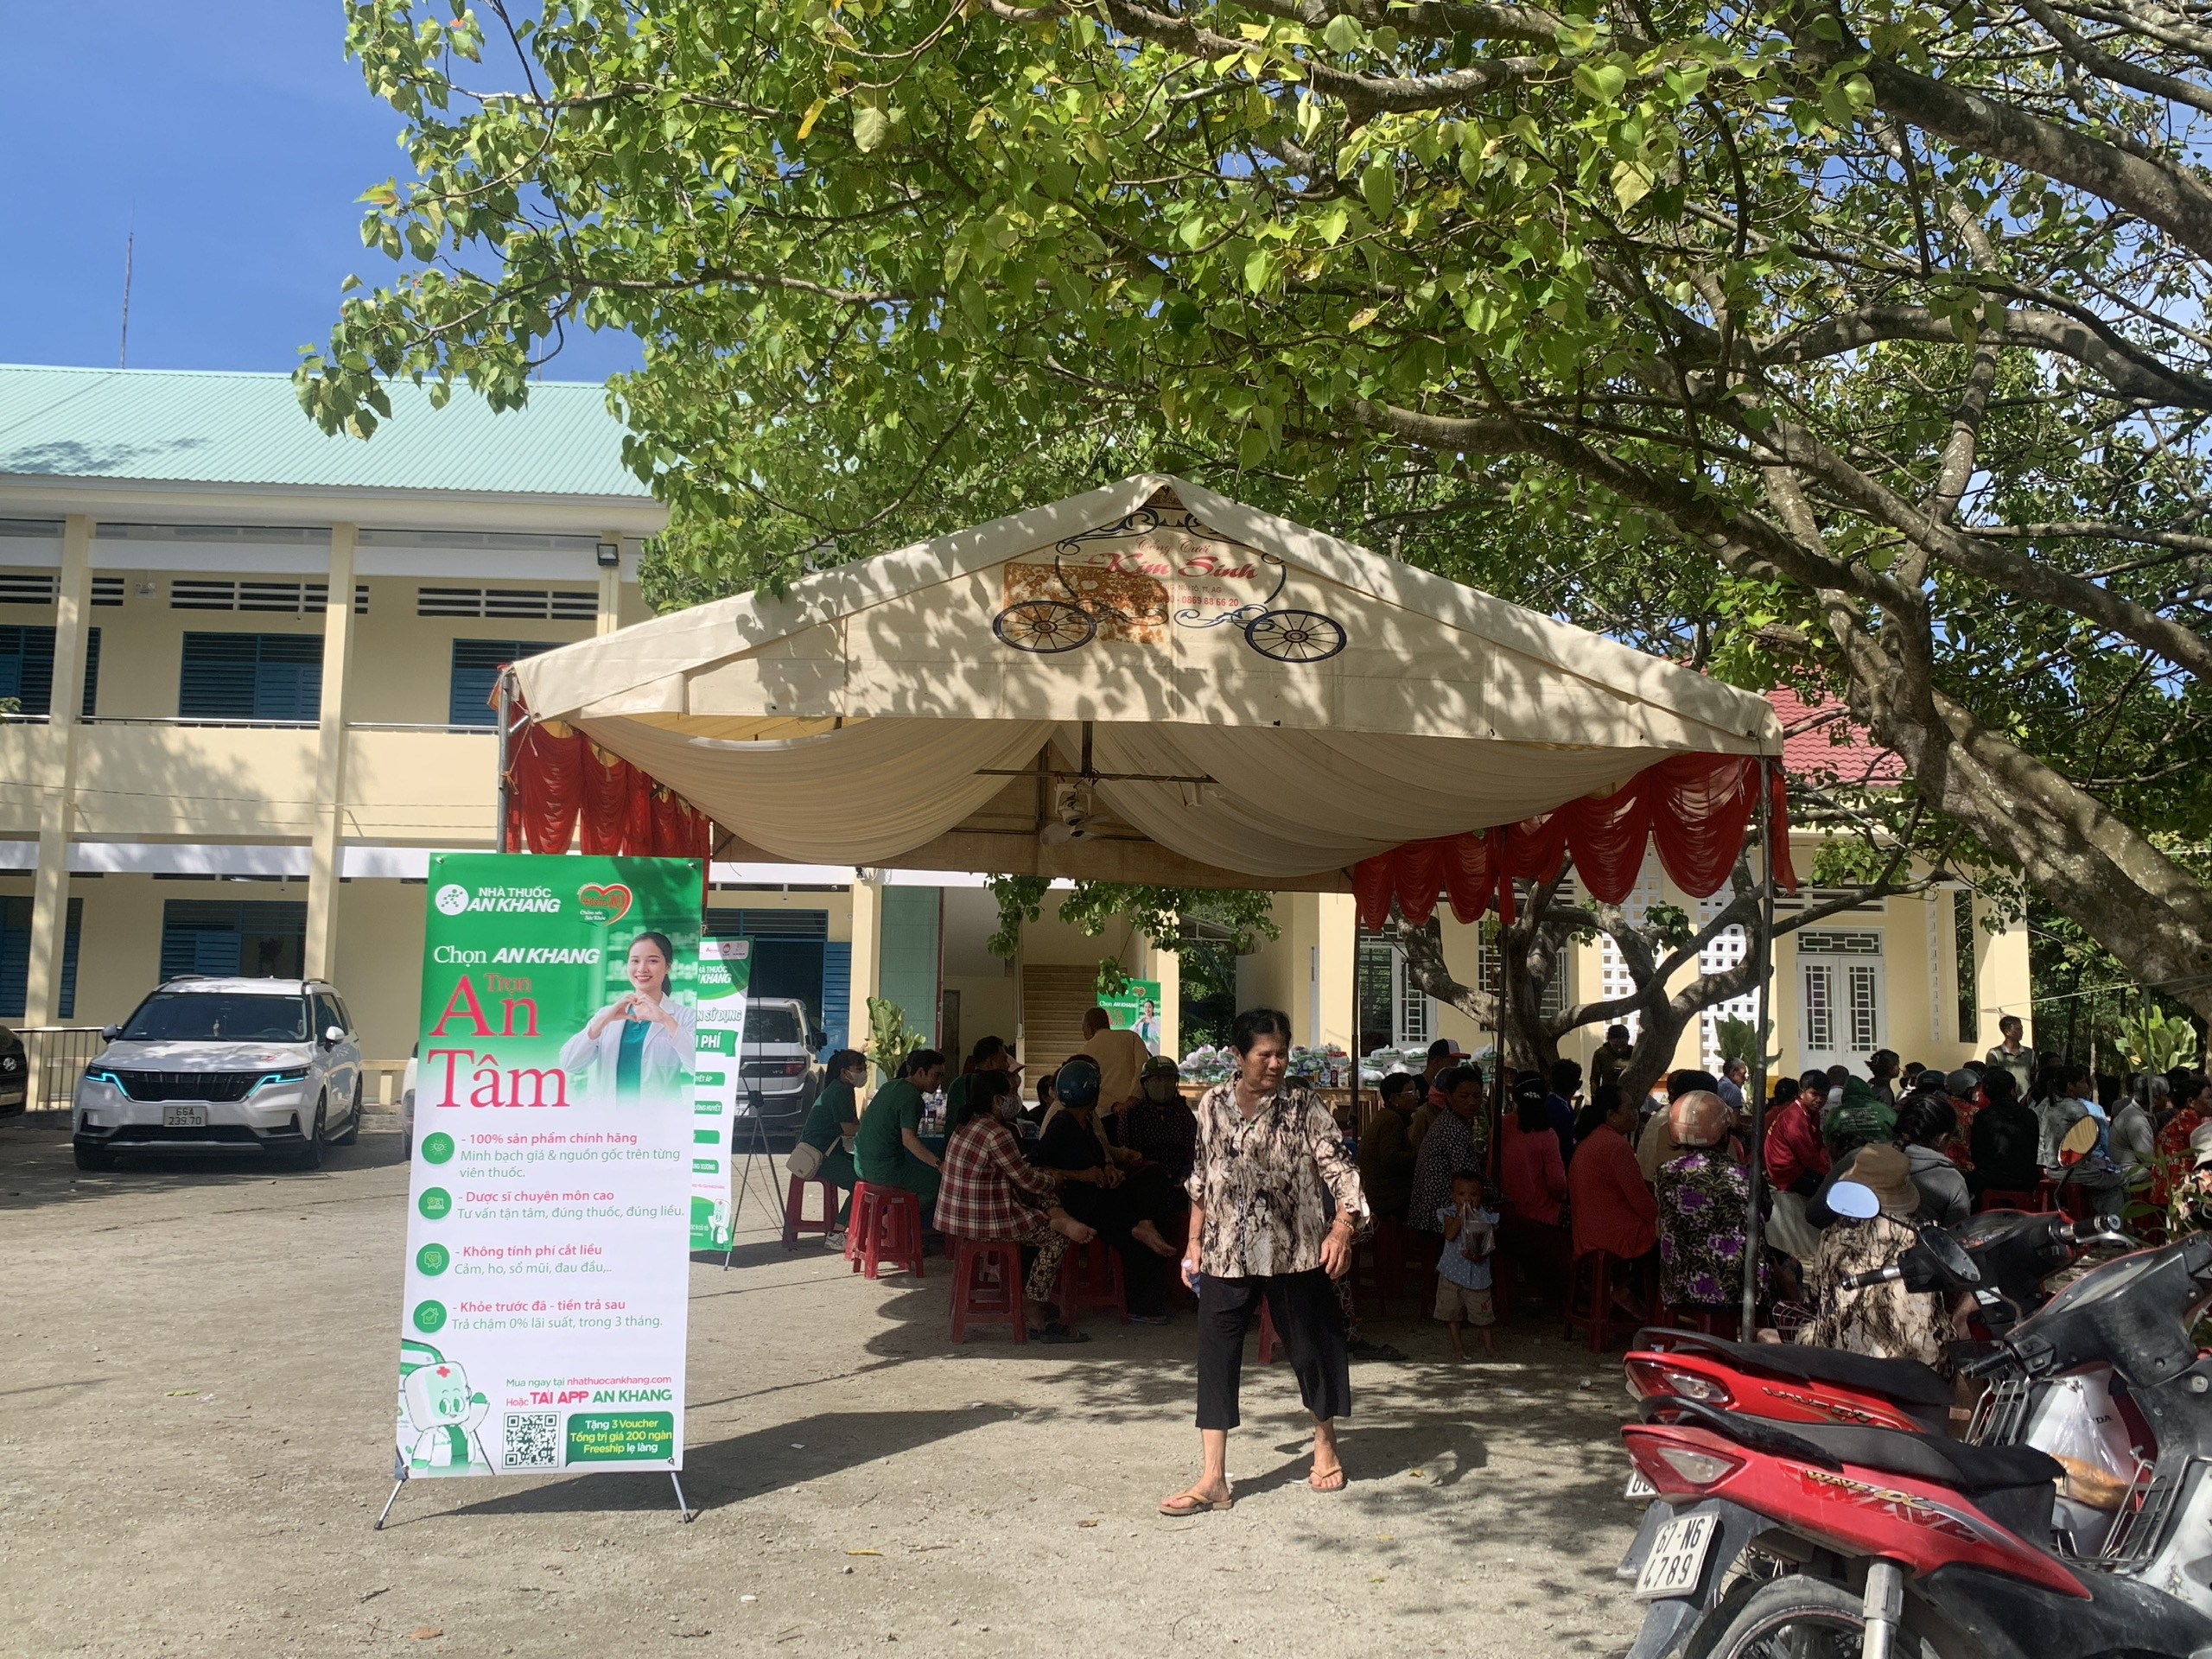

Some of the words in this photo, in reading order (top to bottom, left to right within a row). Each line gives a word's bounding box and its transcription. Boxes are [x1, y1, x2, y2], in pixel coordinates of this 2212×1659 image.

[1086, 552, 1171, 578] Kim
[1178, 556, 1258, 580] Sinh
[1182, 595, 1202, 605] 0869
[1216, 598, 1226, 607] 66
[1229, 598, 1239, 607] 20
[479, 886, 505, 898] NHÀ
[508, 886, 551, 898] THUỐC
[467, 898, 496, 912] AN
[496, 899, 561, 912] KHANG
[434, 945, 487, 968] Chọn
[492, 948, 525, 963] AN
[525, 948, 601, 964] KHANG
[706, 963, 728, 973] THUỐC
[483, 973, 531, 996] Trọn
[700, 973, 733, 984] KHANG
[428, 975, 542, 1037] An
[717, 1010, 741, 1024] DỤNG
[701, 1032, 722, 1049] PHÍ
[427, 1049, 570, 1108] Tâm
[168, 1116, 202, 1125] 239.70
[470, 1134, 504, 1144] 100%
[507, 1133, 528, 1144] sản
[531, 1131, 566, 1146] phẩm
[569, 1132, 603, 1143] chính
[607, 1132, 638, 1145] hãng
[461, 1150, 491, 1161] Minh
[494, 1150, 524, 1163] bạch
[527, 1149, 544, 1163] giá
[548, 1151, 556, 1160] &
[560, 1148, 598, 1162] nguồn
[601, 1147, 623, 1162] gốc
[626, 1148, 650, 1160] trên
[653, 1148, 680, 1161] từng
[460, 1166, 485, 1178] viên
[488, 1166, 525, 1178] thuốc.
[466, 1191, 499, 1205] Dược
[502, 1191, 512, 1201] sĩ
[514, 1190, 558, 1204] chuyên
[563, 1190, 589, 1201] môn
[593, 1192, 614, 1200] cao
[457, 1208, 474, 1219] Tư
[475, 1206, 496, 1219] vấn
[500, 1209, 518, 1221] tận
[522, 1207, 549, 1220] tâm,
[552, 1206, 583, 1220] đúng
[587, 1205, 623, 1217] thuốc,
[626, 1205, 657, 1218] đúng
[660, 1204, 684, 1216] liều.
[463, 1246, 504, 1259] Không
[507, 1245, 531, 1256] tính
[536, 1244, 556, 1258] phí
[558, 1243, 576, 1255] cắt
[580, 1243, 602, 1255] liều
[454, 1263, 484, 1275] Cảm,
[488, 1263, 506, 1275] ho,
[509, 1261, 523, 1274] sổ
[526, 1262, 551, 1274] mũi,
[555, 1262, 577, 1273] đau
[461, 1300, 493, 1313] Khỏe
[496, 1301, 528, 1312] trước
[531, 1300, 547, 1311] đã
[557, 1298, 582, 1311] tiền
[585, 1299, 601, 1310] trả
[605, 1300, 626, 1310] sau
[452, 1318, 470, 1329] Trả
[473, 1318, 505, 1332] chậm
[510, 1318, 528, 1329] 0%
[531, 1317, 545, 1328] lãi
[548, 1315, 576, 1329] suất,
[580, 1318, 612, 1330] trong
[614, 1316, 622, 1326] 3
[626, 1315, 663, 1329] tháng.
[506, 1377, 526, 1388] Mua
[528, 1378, 551, 1389] ngay
[553, 1376, 565, 1388] tại
[567, 1376, 672, 1387] nhathuocankhang.com
[506, 1396, 529, 1408] Hoặc
[557, 1390, 589, 1403] APP
[592, 1390, 615, 1403] AN
[619, 1389, 672, 1402] KHANG
[585, 1420, 609, 1431] Tặng
[612, 1420, 618, 1428] 3
[620, 1418, 659, 1428] Voucher
[570, 1430, 595, 1443] Tổng
[597, 1432, 607, 1443] trị
[609, 1431, 624, 1442] giá
[626, 1430, 646, 1440] 200
[648, 1430, 672, 1441] ngàn
[583, 1443, 625, 1455] Freeship
[638, 1442, 658, 1453] làng
[1806, 1469, 1872, 1492] WAVE
[1656, 1518, 1705, 1554] 67-N6
[1643, 1553, 1694, 1589] 4789
